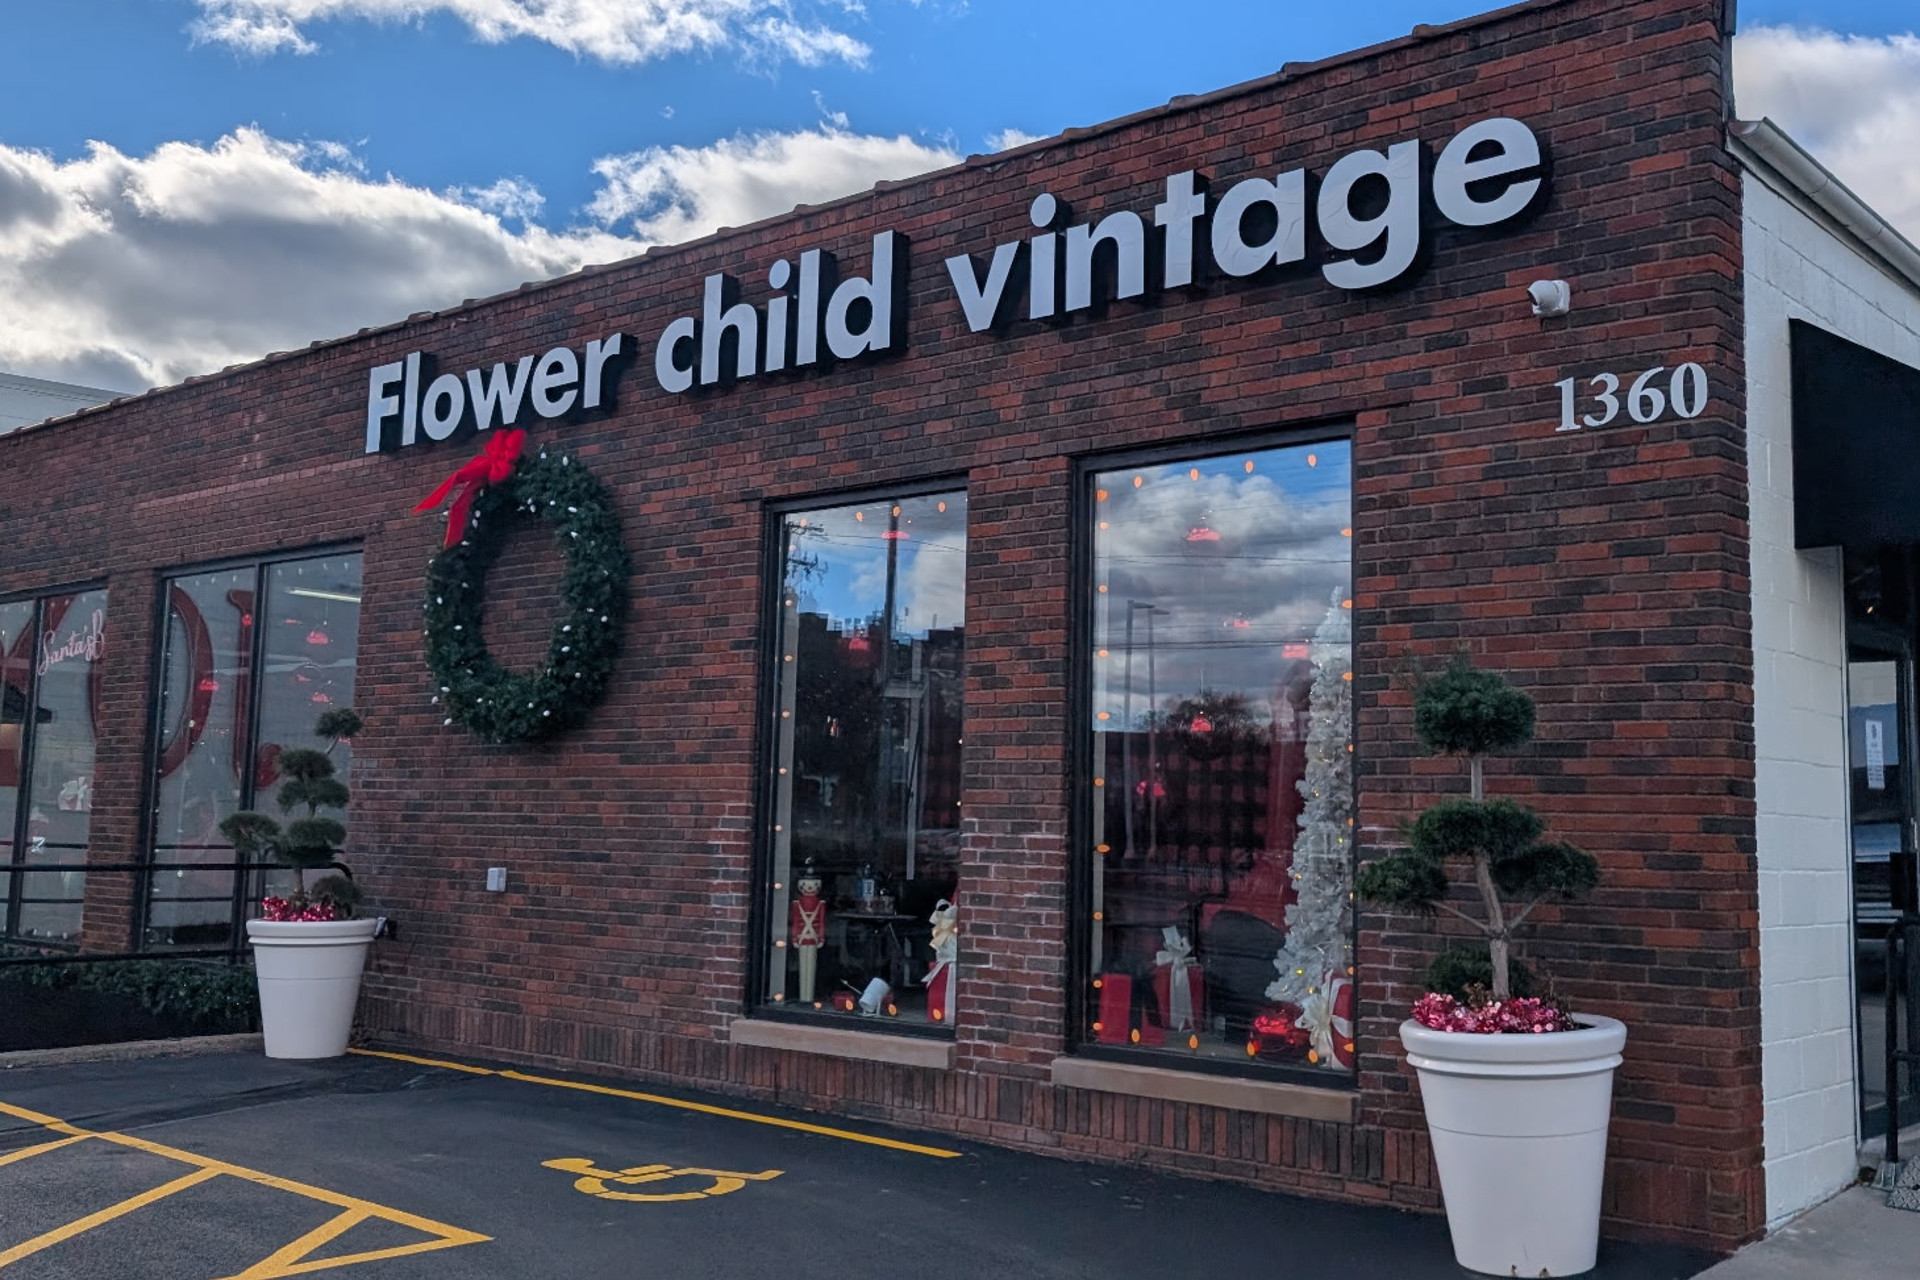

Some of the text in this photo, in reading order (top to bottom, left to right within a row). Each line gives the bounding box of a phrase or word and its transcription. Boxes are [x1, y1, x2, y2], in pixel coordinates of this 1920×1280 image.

[364, 116, 1543, 454] Flower child vintage
[1553, 362, 1708, 432] 1360
